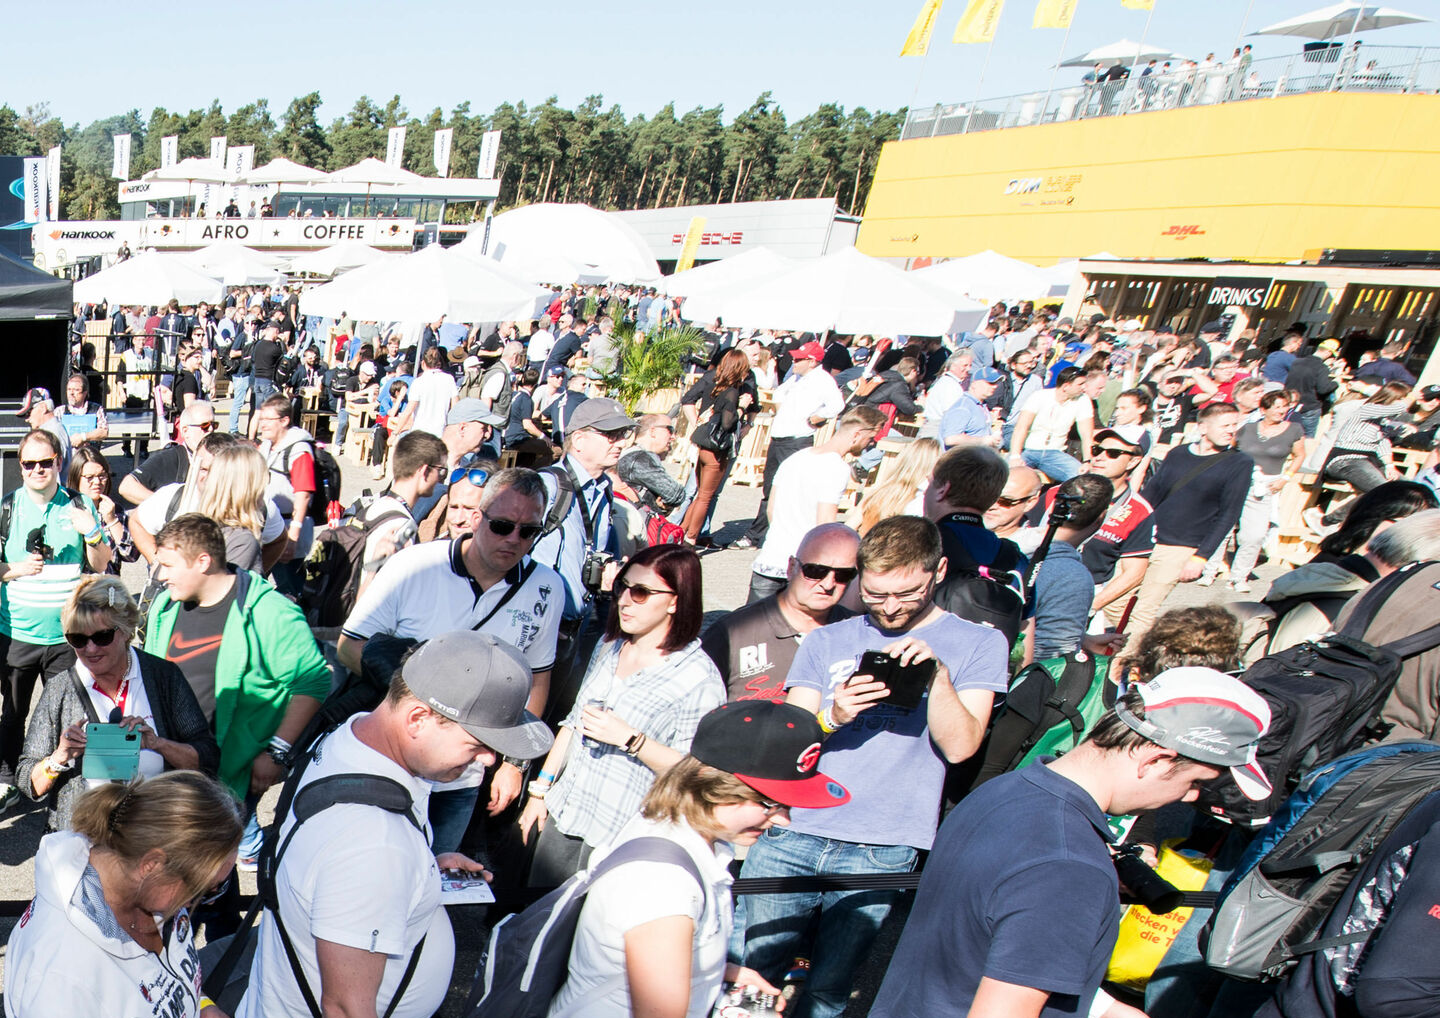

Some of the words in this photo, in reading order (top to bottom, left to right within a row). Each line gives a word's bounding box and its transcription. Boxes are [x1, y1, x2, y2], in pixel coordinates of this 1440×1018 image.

[202, 224, 249, 240] AFRO
[304, 224, 365, 239] COFFEE
[672, 232, 743, 245] PSCHE
[1164, 225, 1203, 236] DHL
[1207, 287, 1265, 306] DRINKS
[952, 514, 978, 523] Canon
[533, 584, 552, 618] 24
[517, 624, 530, 647] MARINE
[1176, 735, 1229, 756] Rockenfeller
[1140, 931, 1160, 944] die
